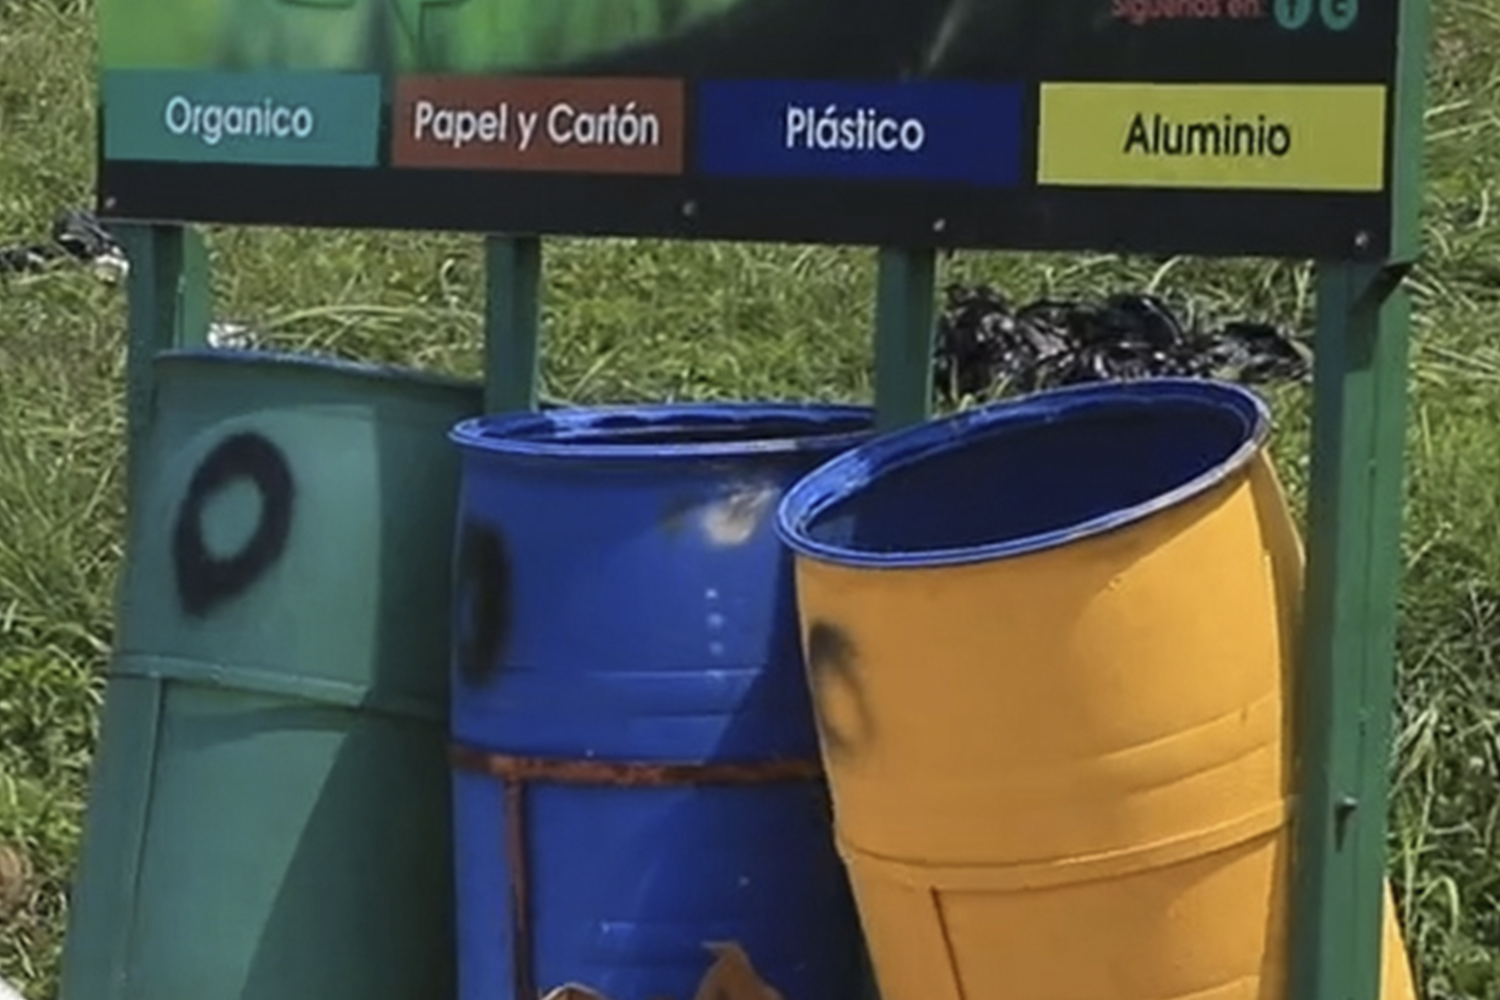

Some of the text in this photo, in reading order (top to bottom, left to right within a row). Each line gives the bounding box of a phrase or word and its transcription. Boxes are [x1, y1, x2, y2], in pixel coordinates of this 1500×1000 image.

[165, 95, 313, 145] Organico
[414, 101, 660, 151] Papel y Cartón
[787, 104, 925, 151] Plástico
[1123, 112, 1291, 156] Aluminio
